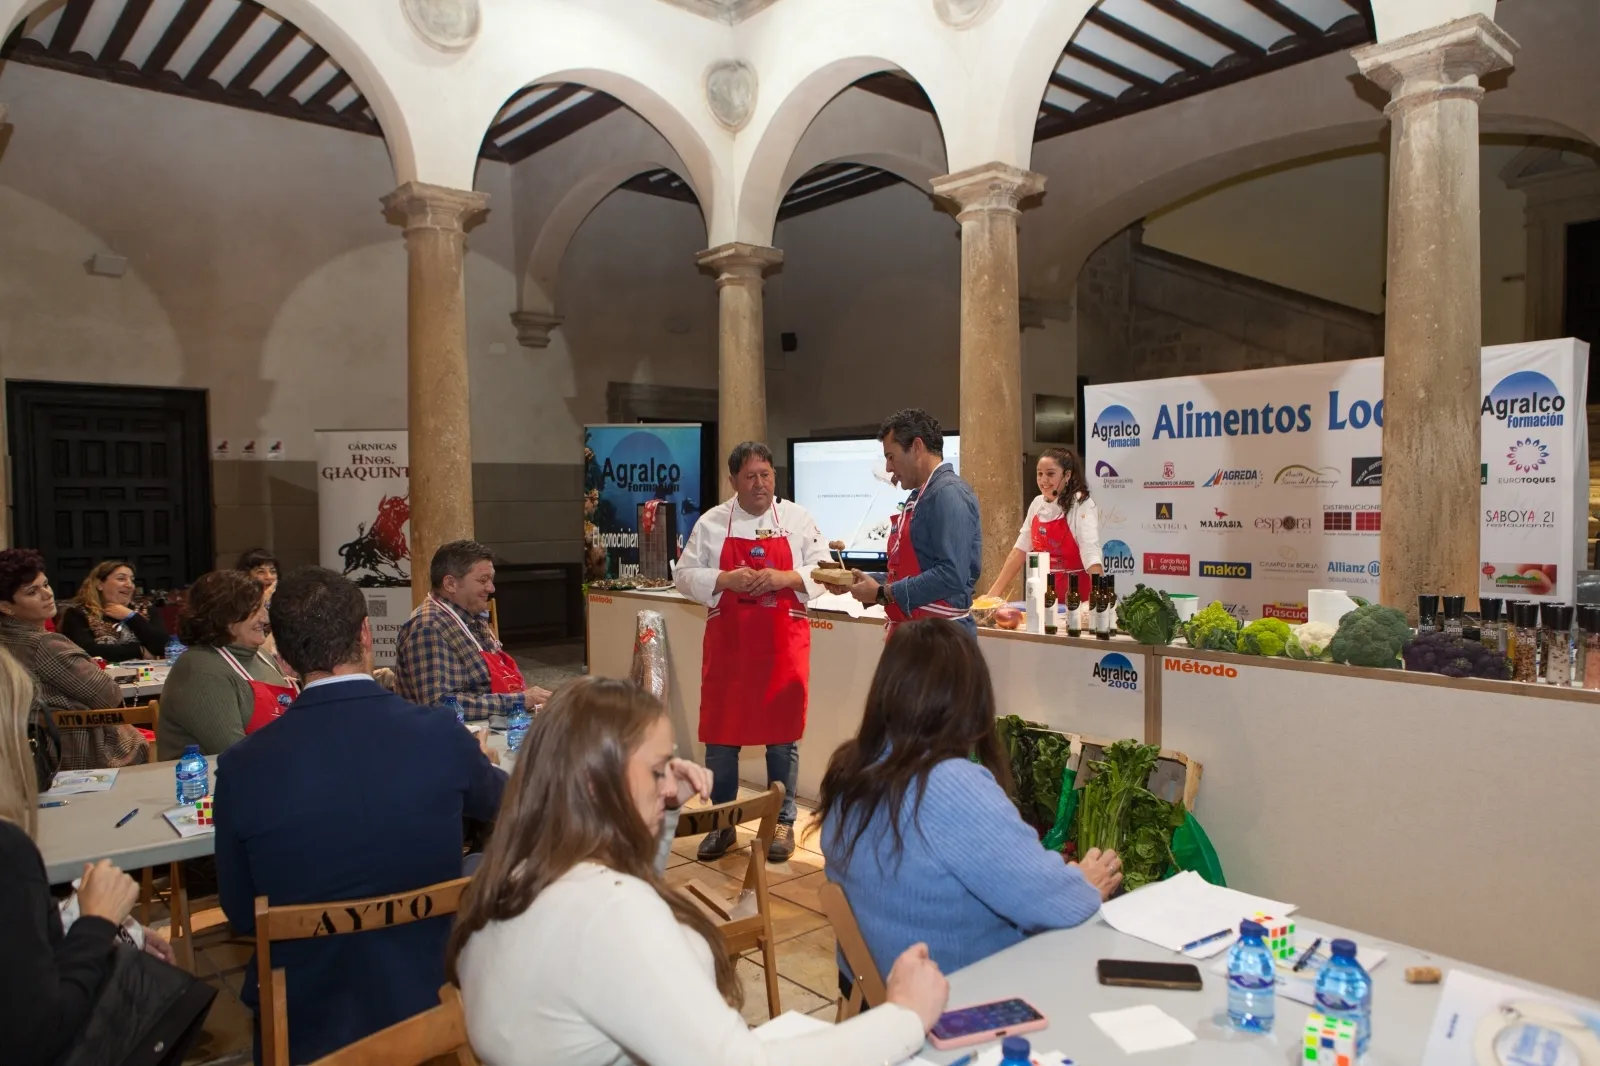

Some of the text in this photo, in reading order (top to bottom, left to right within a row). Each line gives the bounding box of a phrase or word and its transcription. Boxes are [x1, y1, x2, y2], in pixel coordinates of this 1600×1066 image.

[1481, 392, 1565, 420] Agralco
[1152, 401, 1312, 440] Alimentos
[1507, 412, 1564, 428] Formación
[1091, 420, 1140, 441] Agralco
[348, 441, 397, 451] CÁRNICAS
[1108, 437, 1140, 448] Formación
[601, 457, 681, 489] Agralco
[1222, 470, 1257, 480] AGREDA
[1485, 510, 1555, 523] SABOYA 21
[1200, 520, 1243, 528] MALVASIA
[592, 526, 600, 548] El
[602, 527, 639, 548] conocimien
[1103, 551, 1135, 573] gralco
[1160, 557, 1175, 565] Cardo
[1327, 561, 1365, 573] Allianz
[1203, 563, 1247, 577] makro
[1265, 607, 1308, 619] Pascua
[809, 619, 833, 630] todo
[372, 637, 397, 645] ICER
[1092, 662, 1138, 683] Agralco
[1164, 658, 1238, 678] Método
[1108, 679, 1137, 690] 2000
[58, 712, 125, 726] AYTO AGREDA
[687, 807, 743, 834] YTO
[313, 894, 433, 937] AYTO
